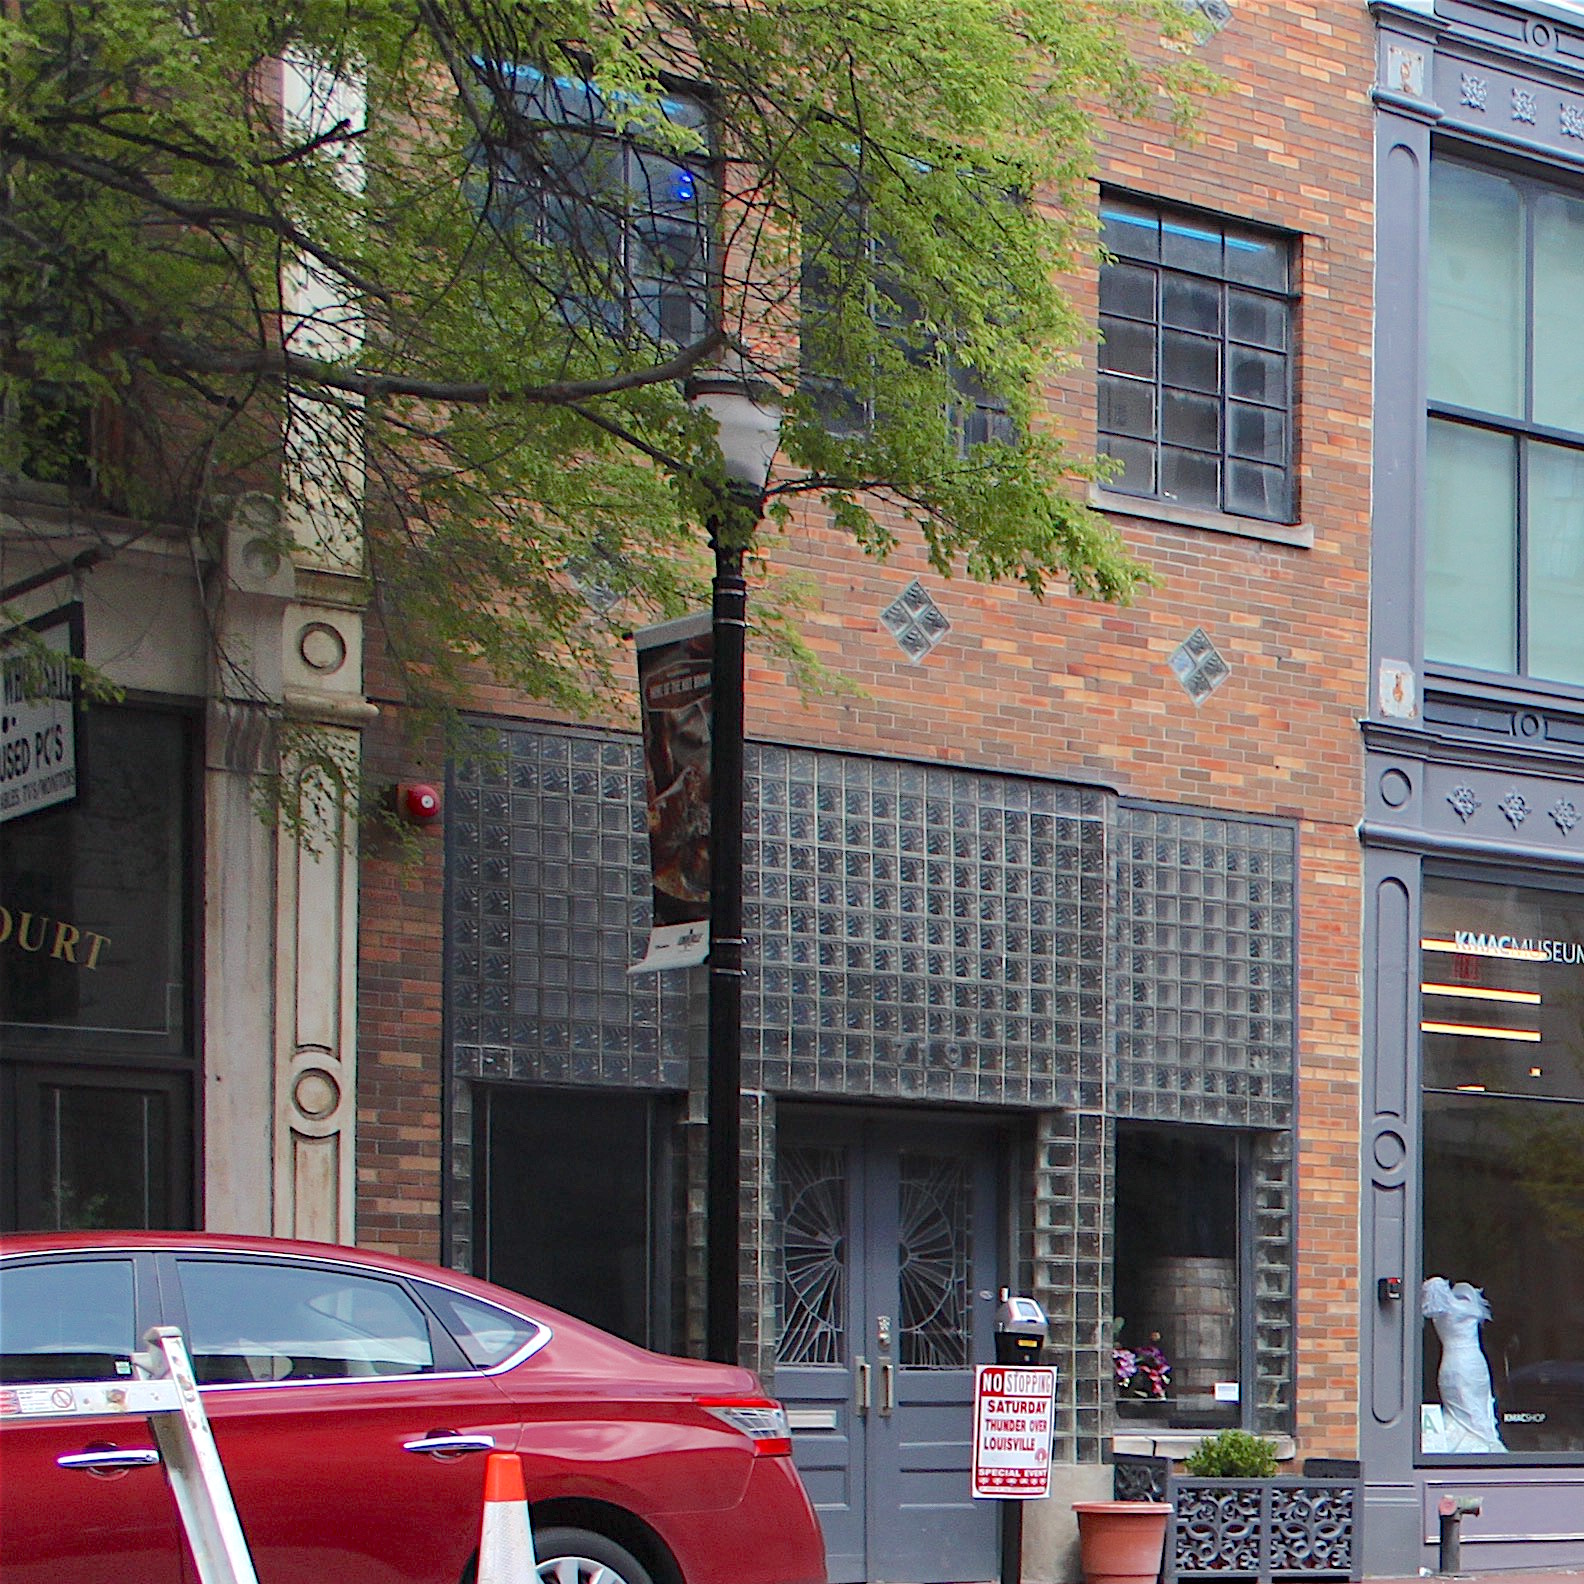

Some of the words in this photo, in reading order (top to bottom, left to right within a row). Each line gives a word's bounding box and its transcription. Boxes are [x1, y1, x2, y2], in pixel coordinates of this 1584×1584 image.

[982, 1373, 1003, 1392] NO
[1006, 1373, 1050, 1393] STOPPING
[988, 1400, 1047, 1414] SATURDAY
[985, 1419, 1026, 1432] THUNDER
[1029, 1420, 1047, 1432] OVER
[984, 1437, 1035, 1451] LOUISVILLE
[979, 1468, 1021, 1477] SPECIAL
[1024, 1469, 1047, 1477] EVENT
